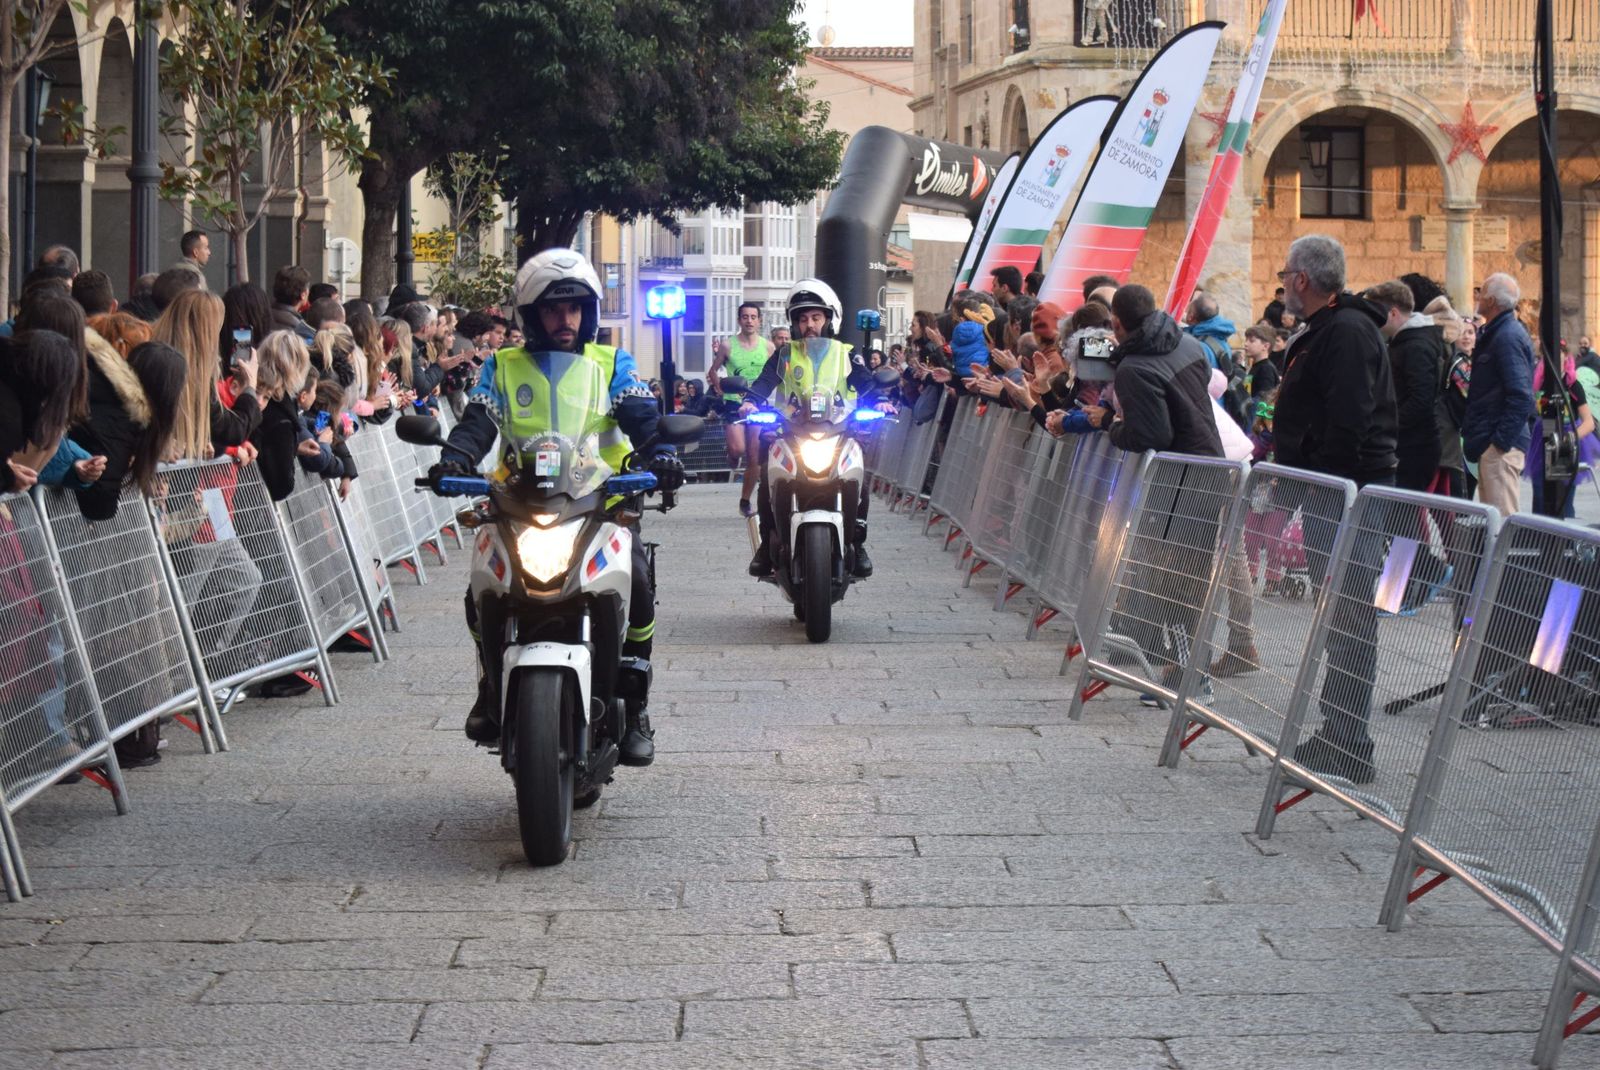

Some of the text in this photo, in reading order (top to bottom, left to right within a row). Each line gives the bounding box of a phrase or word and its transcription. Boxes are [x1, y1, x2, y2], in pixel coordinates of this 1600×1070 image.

[1107, 146, 1158, 181] DE ZAMORA
[1113, 137, 1163, 169] AYUNTAMIENTO
[554, 287, 575, 295] GIVI
